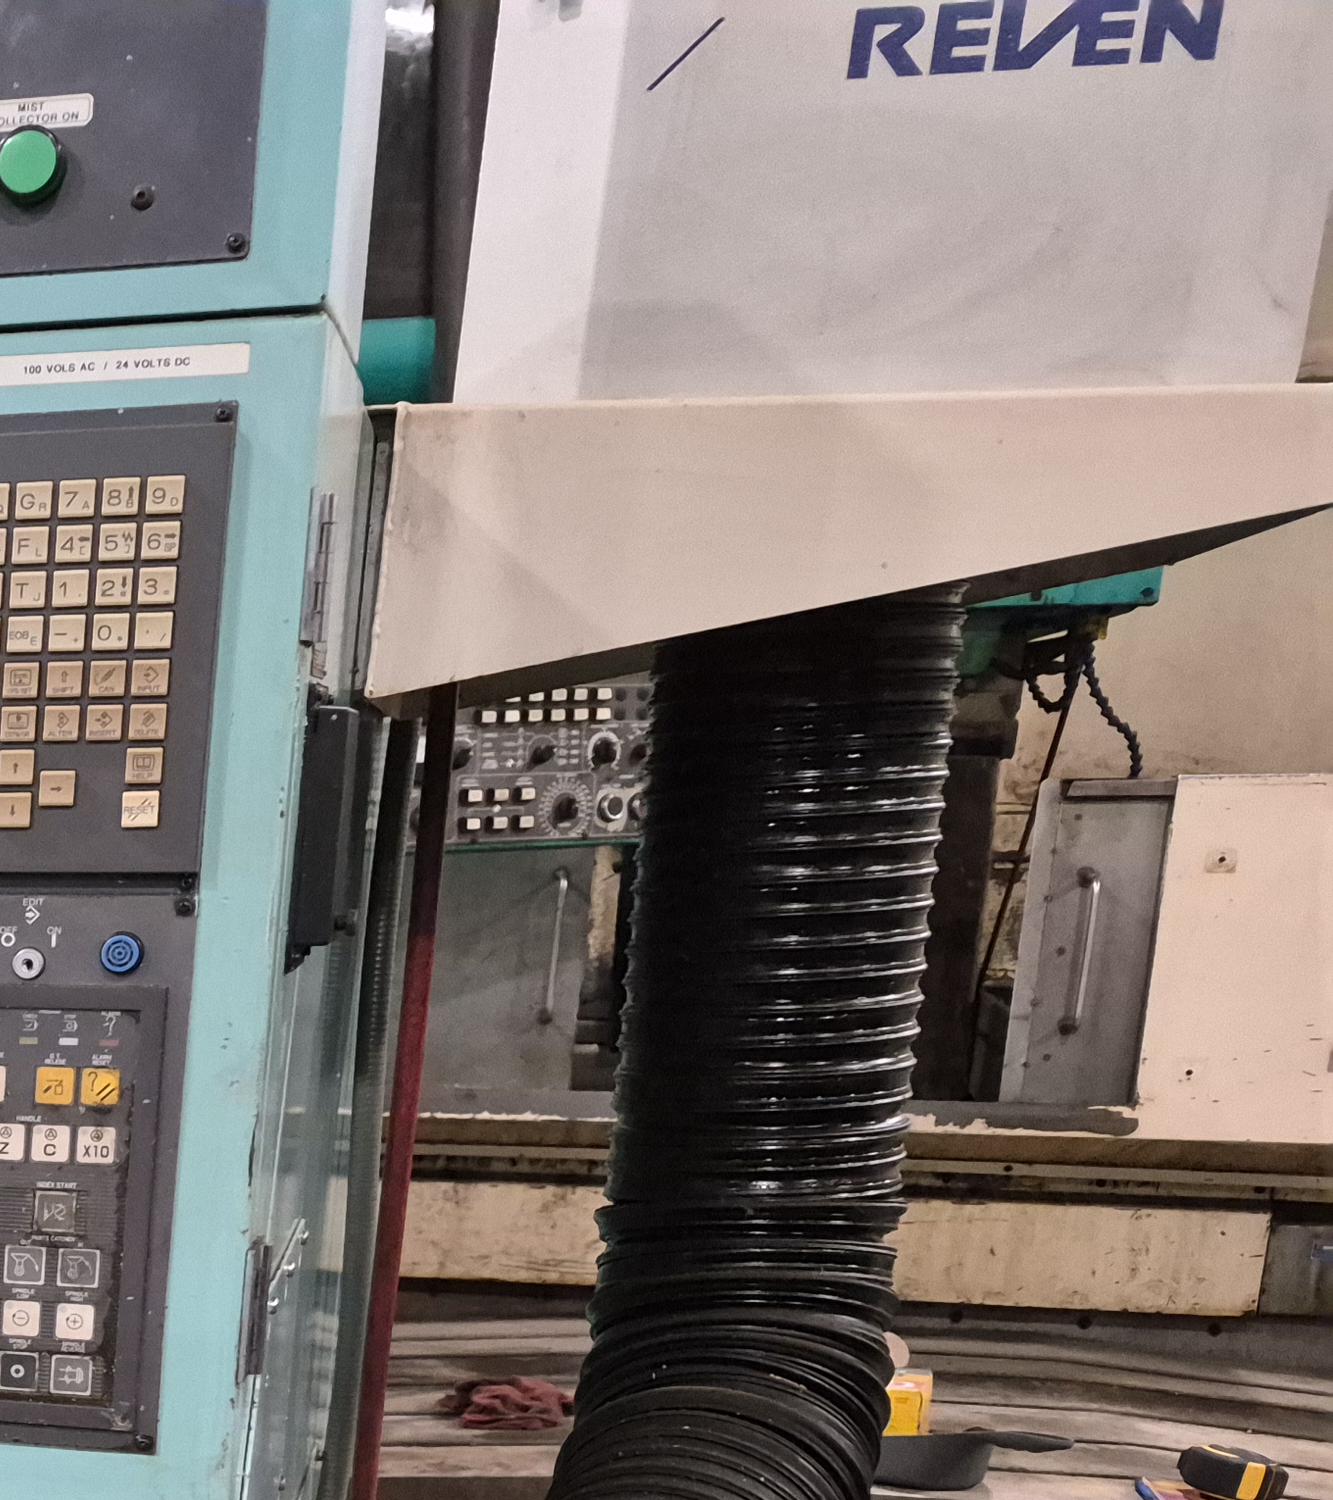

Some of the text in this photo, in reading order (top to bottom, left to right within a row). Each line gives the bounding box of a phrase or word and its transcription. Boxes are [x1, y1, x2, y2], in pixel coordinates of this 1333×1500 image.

[846, 0, 1225, 80] REVEN
[17, 102, 44, 112] MIST
[61, 111, 79, 122] ON
[23, 356, 192, 375] 100 VOLS AC / 24 VOLTS DC
[19, 493, 47, 512] G R
[64, 491, 91, 510] 7 A
[107, 489, 122, 506] 8
[151, 487, 166, 504] 9
[17, 537, 43, 557] F L
[60, 536, 75, 553] 4
[104, 534, 119, 551] 5
[146, 532, 162, 550] 6
[15, 582, 30, 599] T
[58, 581, 68, 598] 1
[101, 579, 116, 597] 2
[143, 577, 159, 596] 3
[97, 685, 116, 694] CAN
[123, 804, 156, 815] RESET
[22, 897, 45, 906] EDIT
[0, 925, 62, 936] OFF ON
[43, 1143, 57, 1157] C
[82, 1145, 110, 1159] X10
